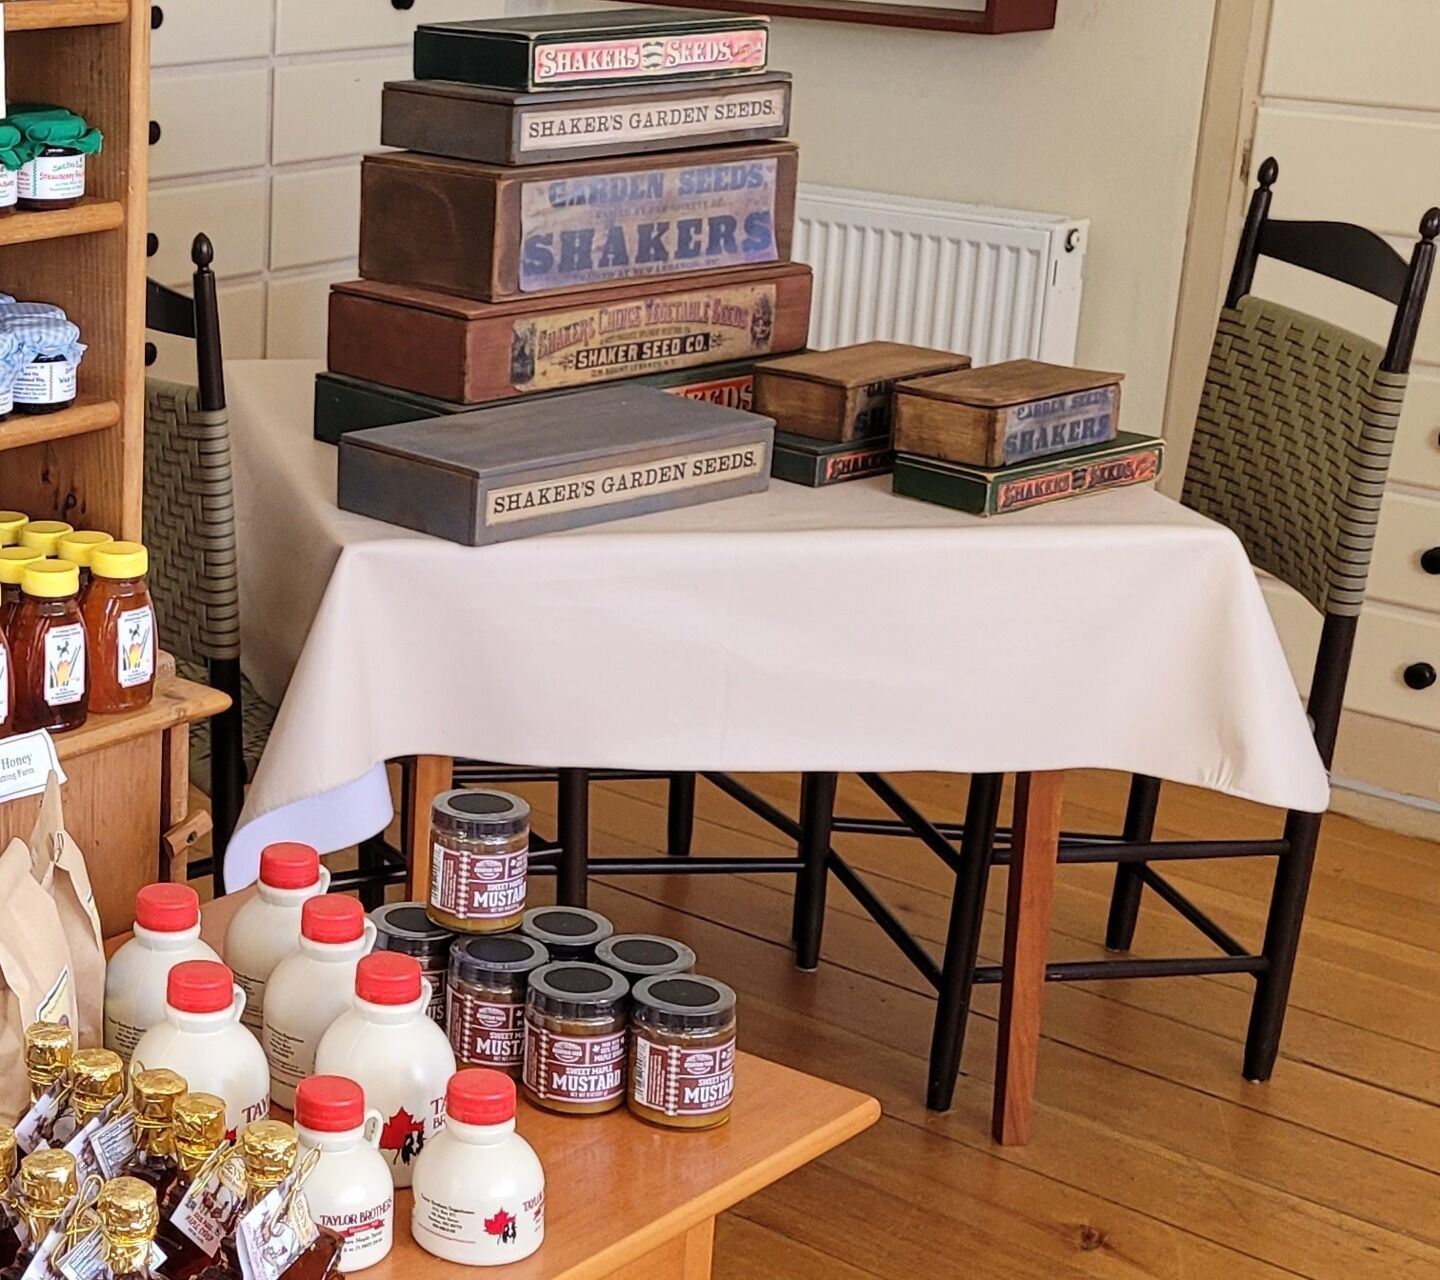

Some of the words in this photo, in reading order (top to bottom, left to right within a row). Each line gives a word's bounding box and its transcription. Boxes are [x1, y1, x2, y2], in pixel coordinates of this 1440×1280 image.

[539, 46, 639, 77] SHAKERS
[529, 114, 623, 138] SHAKER'S
[629, 106, 709, 129] GARDEN
[714, 100, 775, 120] SEEDS.
[548, 173, 665, 207] GARDEN
[523, 210, 771, 275] SHAKERS
[598, 305, 642, 336] CHOICE
[577, 345, 638, 368] SHAKER
[641, 338, 681, 359] SEED
[686, 334, 708, 353] CO.
[1017, 398, 1066, 420] GARDEN
[1006, 414, 1110, 456] SHAKERS
[494, 480, 595, 514] SHAKER'S
[602, 462, 686, 494] GARDEN
[692, 451, 757, 477] SEEDS.
[1003, 474, 1071, 509] SHAKERS
[1, 753, 33, 771] Honey
[17, 767, 35, 778] Farm
[489, 1032, 513, 1040] SWEET
[566, 1067, 590, 1075] SWEET
[592, 1065, 613, 1074] MAPLE
[594, 1053, 612, 1062] MAPLE
[552, 1069, 621, 1091] MUSTARD
[698, 1078, 720, 1086] SWEET
[320, 1215, 357, 1227] TAYLOR
